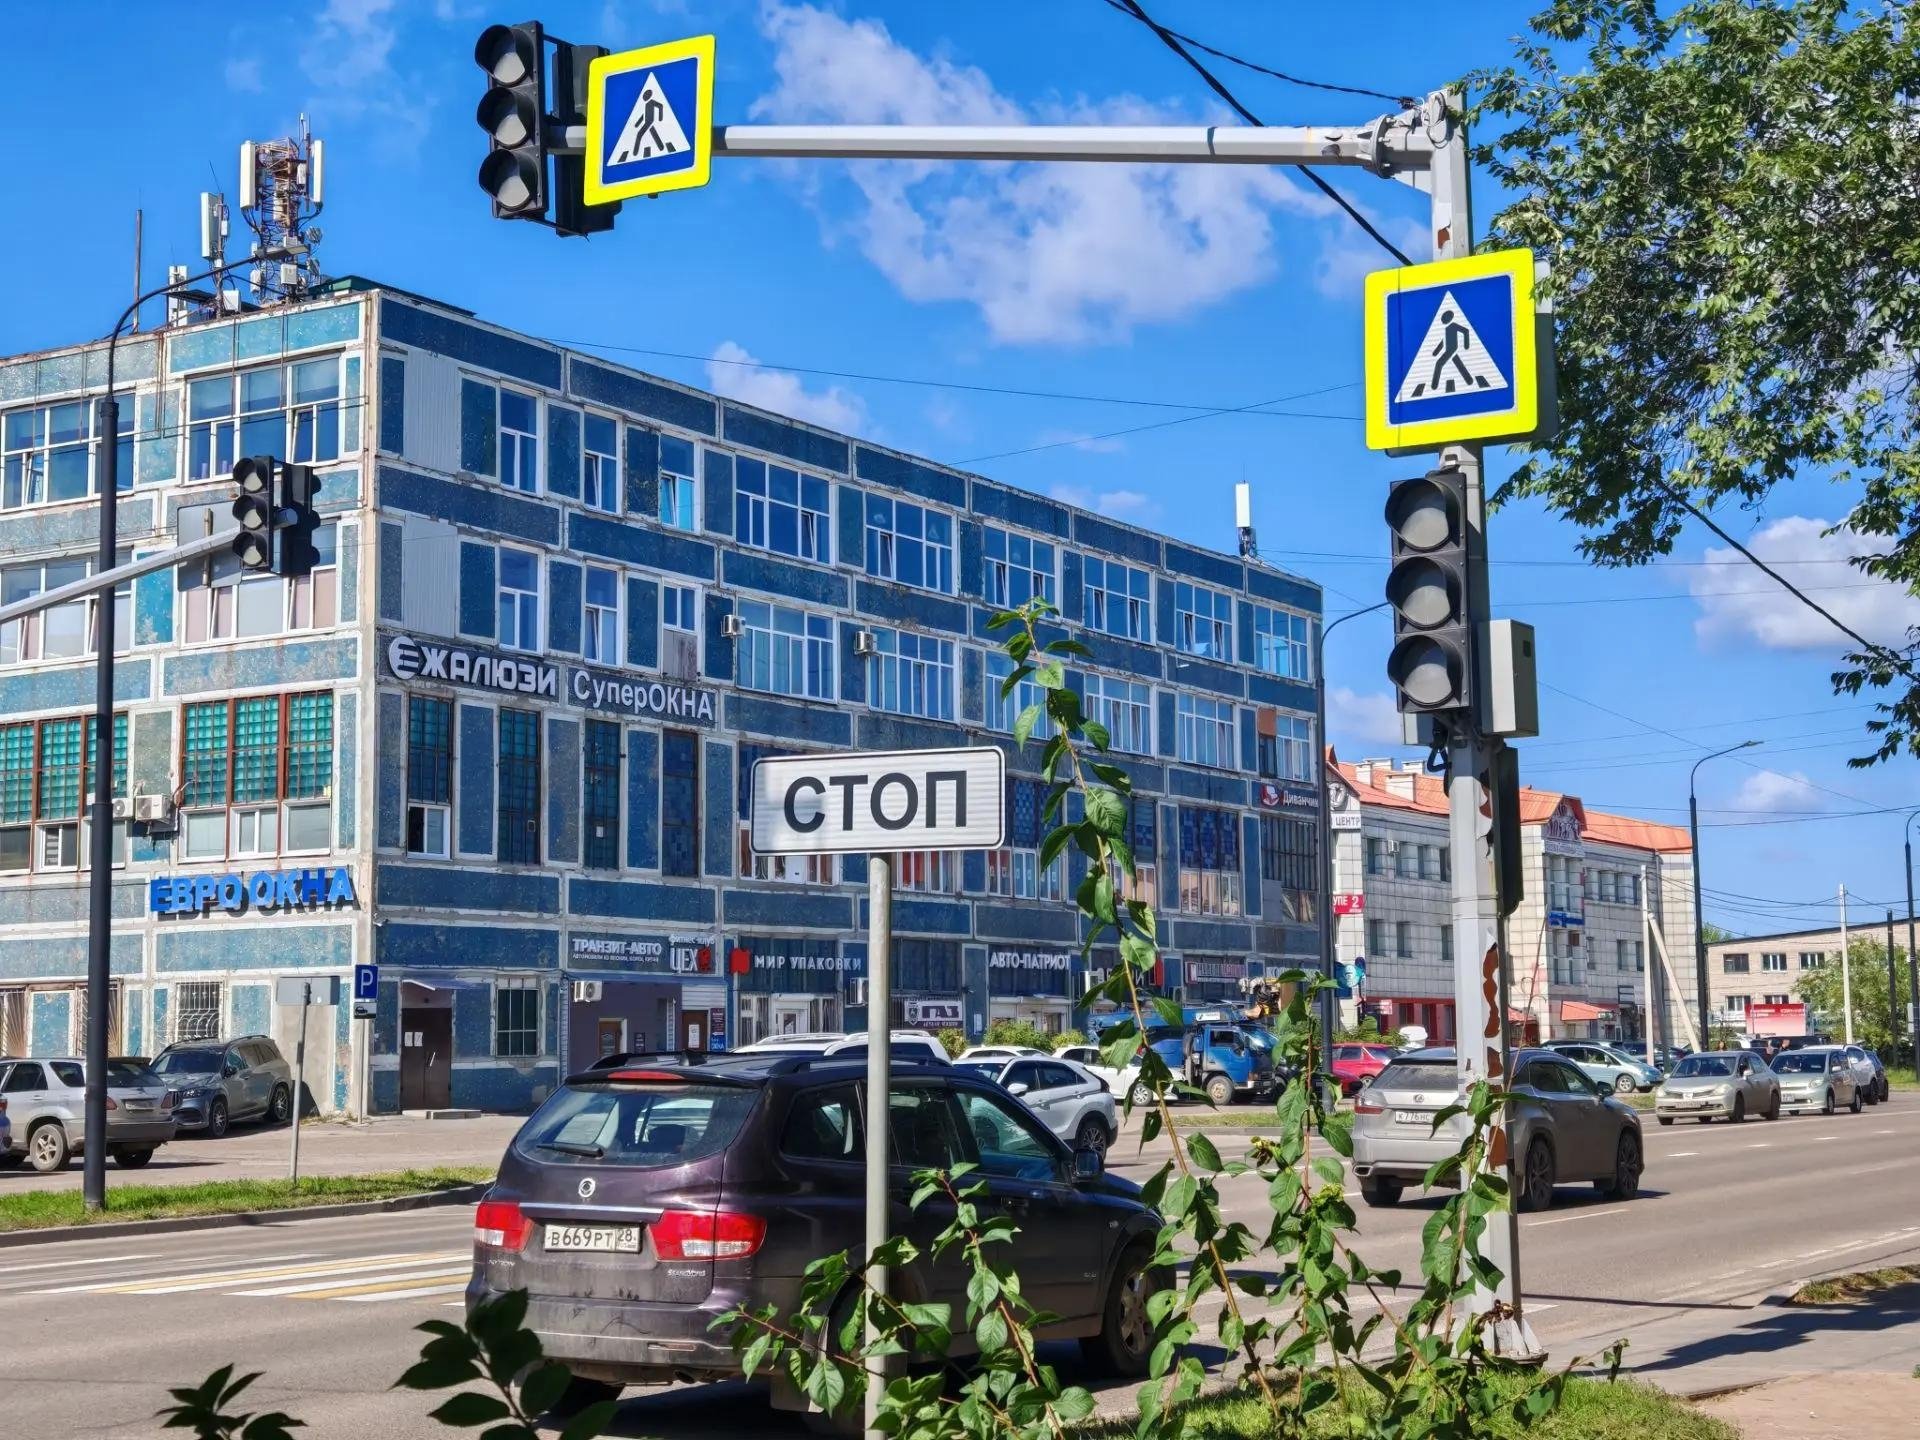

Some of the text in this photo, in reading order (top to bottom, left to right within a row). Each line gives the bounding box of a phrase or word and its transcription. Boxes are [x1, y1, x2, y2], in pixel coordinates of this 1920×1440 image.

[573, 670, 714, 721] СуперОКНА
[783, 770, 968, 834] СТОП
[1335, 815, 1361, 827] ЦЕНТР
[150, 867, 354, 912] ЕВРО ОКНА
[1351, 895, 1360, 908] 2
[572, 938, 662, 956] ТРАНЗИТ-АВТО
[670, 947, 698, 974] ЦЕХ
[754, 955, 862, 971] МИР УПАКОВКИ
[989, 951, 1071, 970] АВТО-ПАТРИОТ
[360, 968, 373, 996] P
[922, 1005, 960, 1018] ГАЗ
[550, 1228, 633, 1248] В669РТ 28
